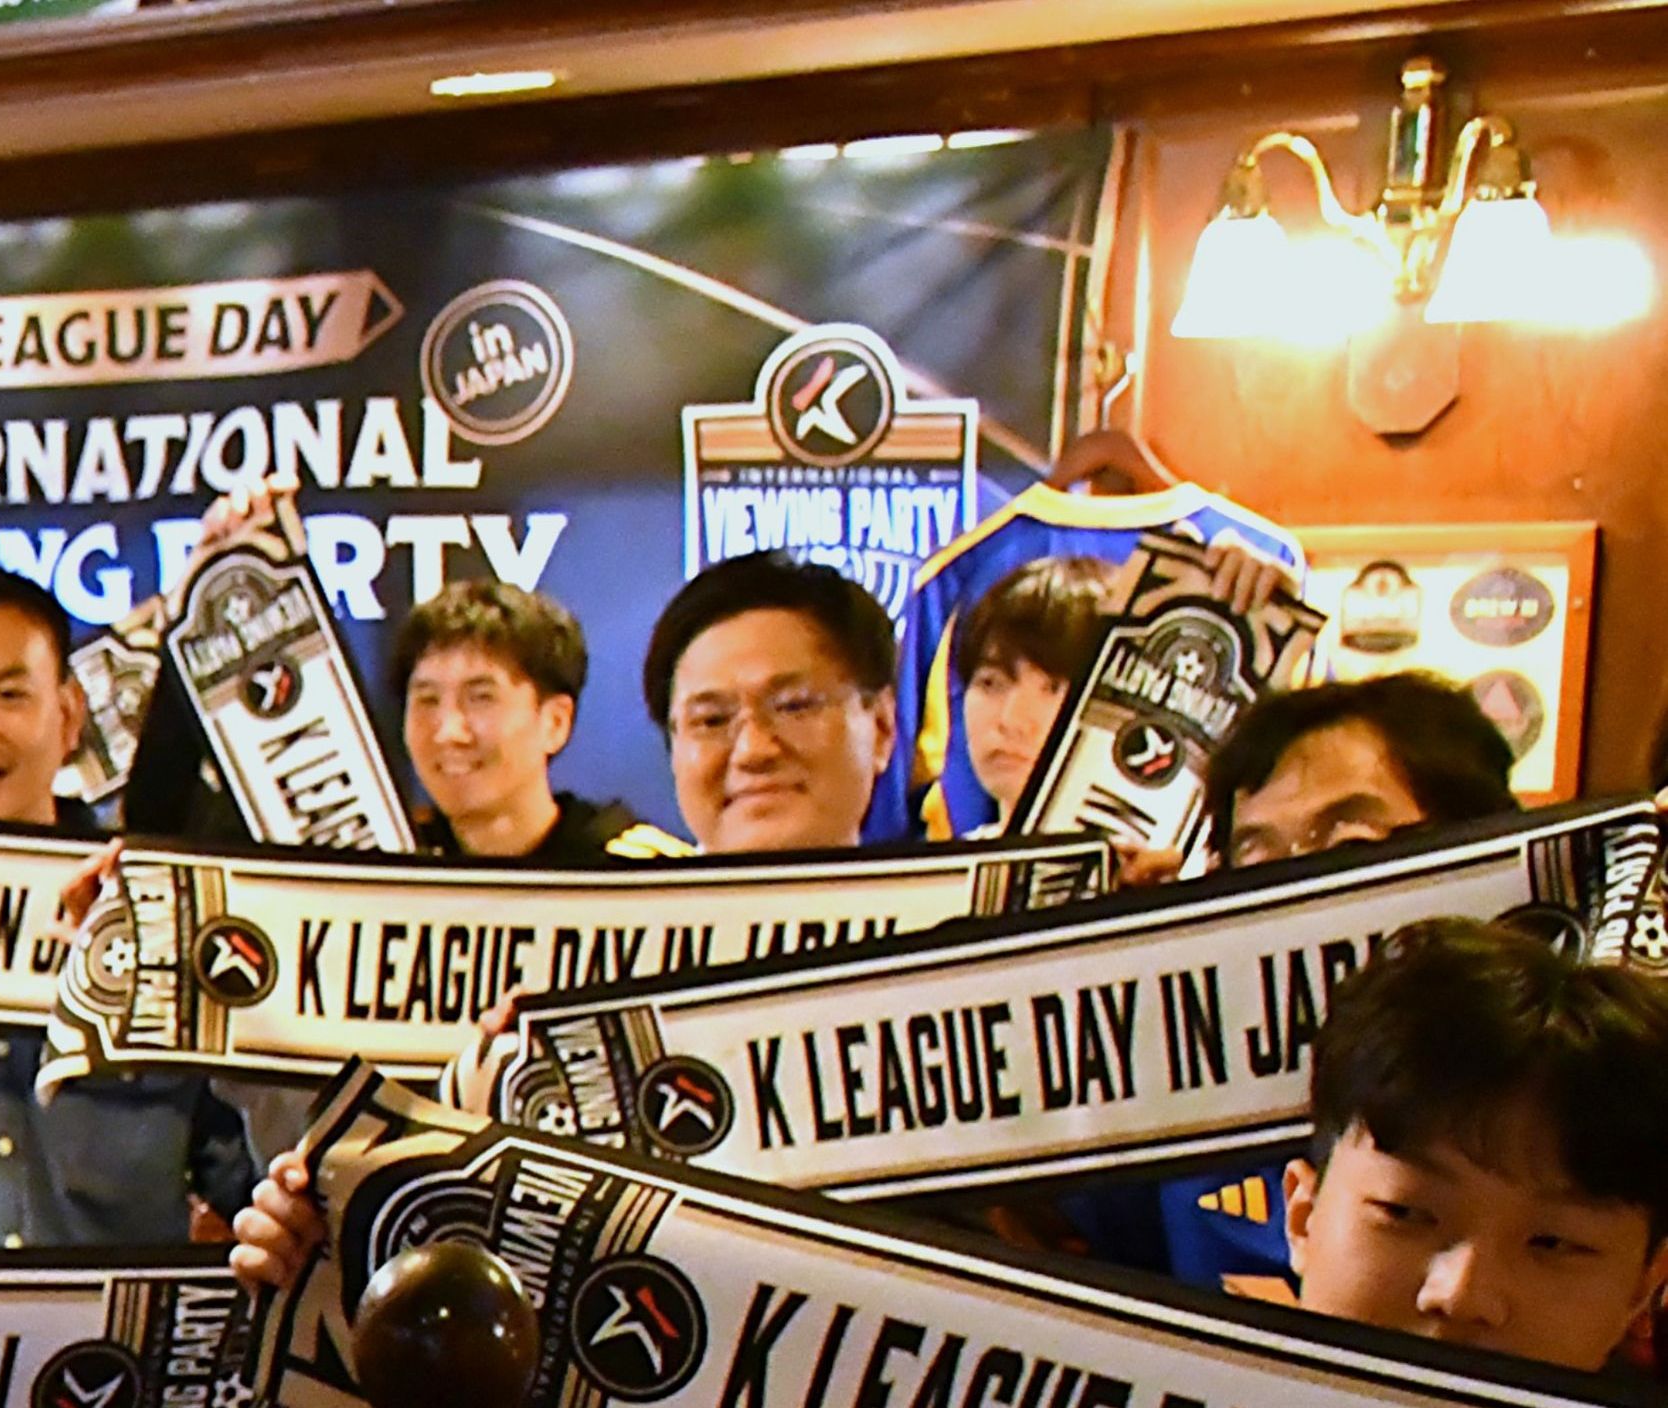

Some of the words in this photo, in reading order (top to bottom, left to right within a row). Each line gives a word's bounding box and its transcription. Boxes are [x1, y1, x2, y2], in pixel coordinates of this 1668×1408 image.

[208, 293, 343, 357] DAY
[469, 319, 514, 356] in
[450, 348, 548, 406] JAPAN
[702, 487, 843, 562] VIEWING
[847, 487, 959, 558] PARTY
[260, 716, 330, 764] K
[295, 921, 330, 1020] K
[344, 920, 536, 1021] LEAGUE
[547, 1016, 622, 1130] VIEWING
[747, 1038, 793, 1150] K
[812, 1003, 1022, 1142] LEAGUE
[1034, 979, 1141, 1111] DAY
[1159, 964, 1229, 1092] IN
[166, 1283, 239, 1376] PARTY
